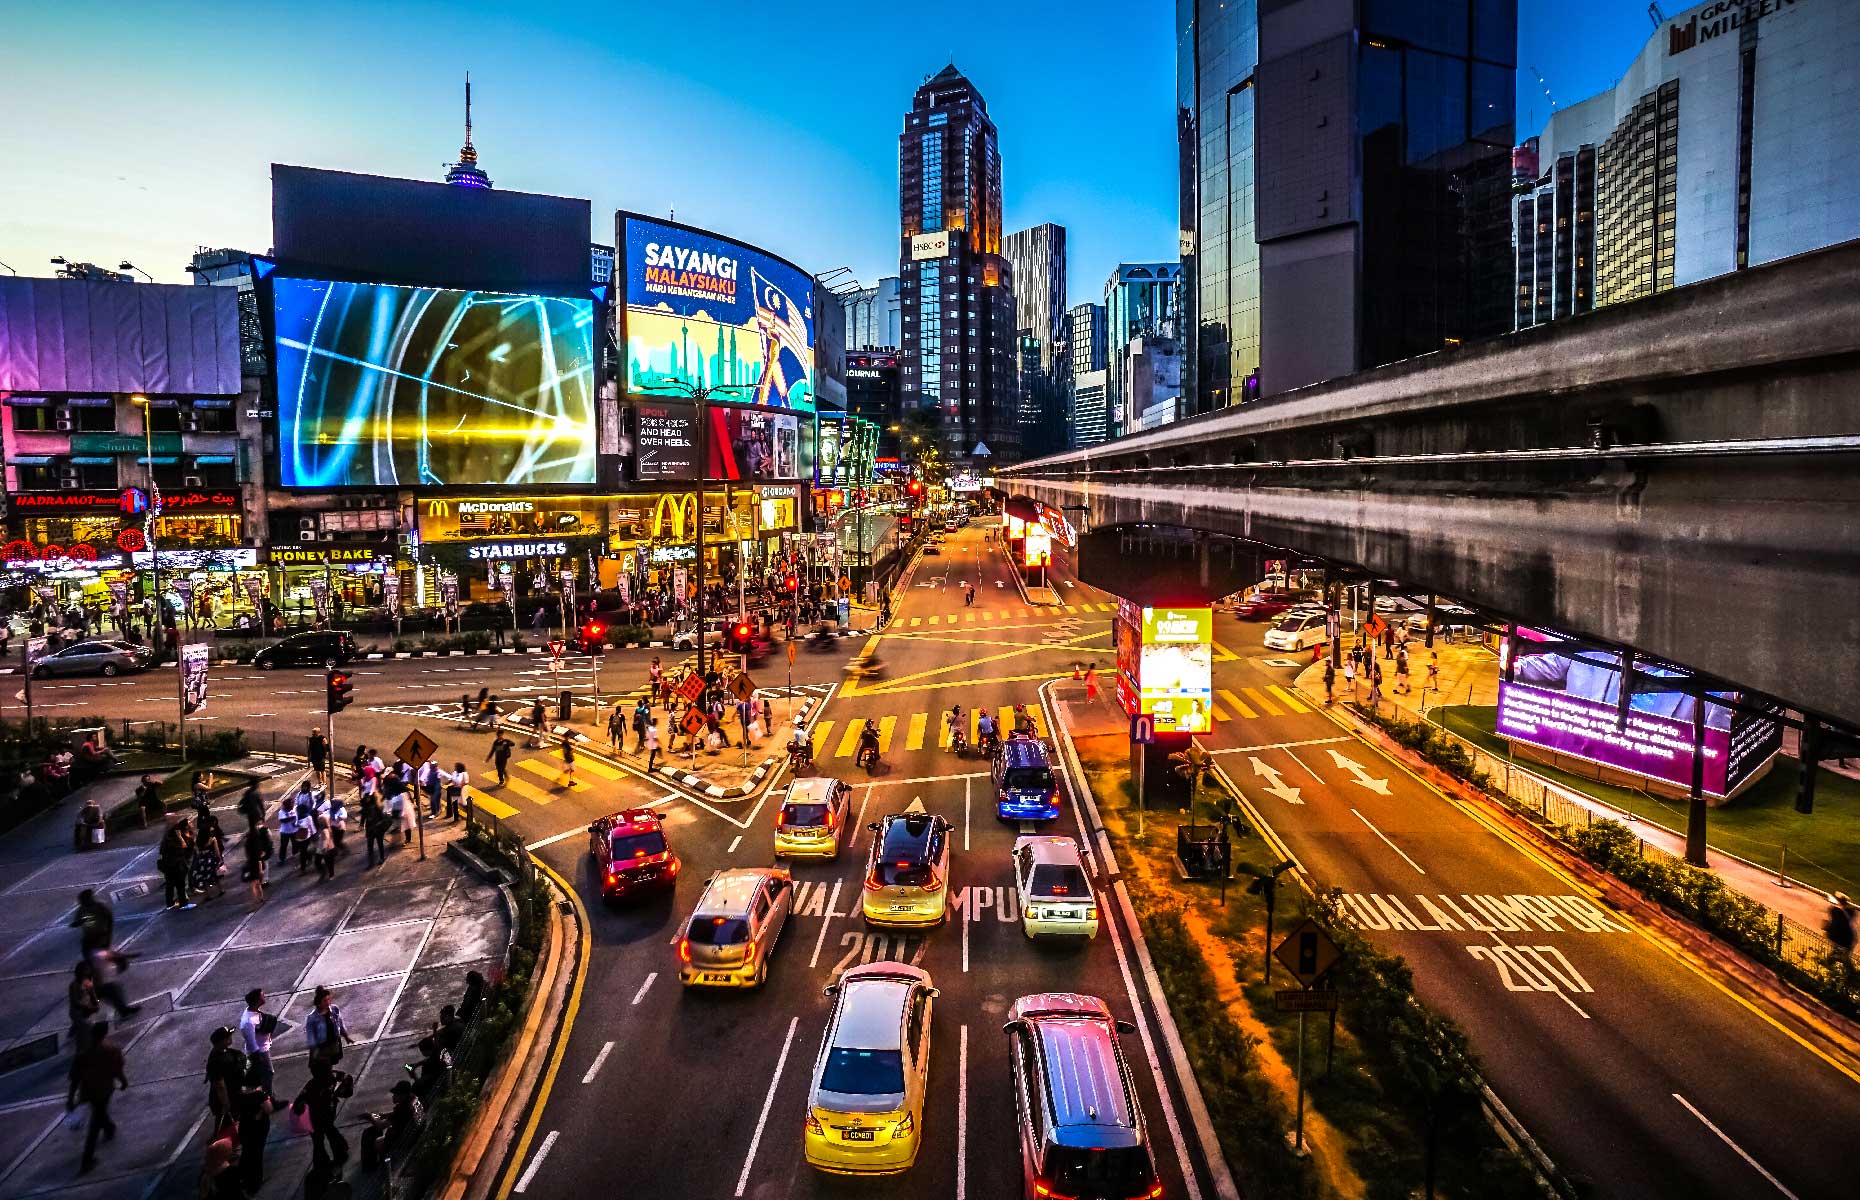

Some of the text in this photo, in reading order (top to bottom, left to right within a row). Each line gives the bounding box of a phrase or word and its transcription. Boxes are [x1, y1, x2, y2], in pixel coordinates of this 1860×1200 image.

[913, 241, 933, 251] HSBC
[645, 243, 737, 281] SAYANGI
[645, 266, 736, 295] MALAYSIAKU
[640, 428, 682, 437] AND HEAD
[640, 437, 662, 446] OVER
[459, 501, 533, 513] McDonald's
[270, 550, 325, 562] HONEY
[330, 549, 373, 560] BAKE
[469, 542, 567, 559] STARBUCKS
[1461, 894, 1632, 933] LUMPUR
[1466, 945, 1595, 993] 2017
